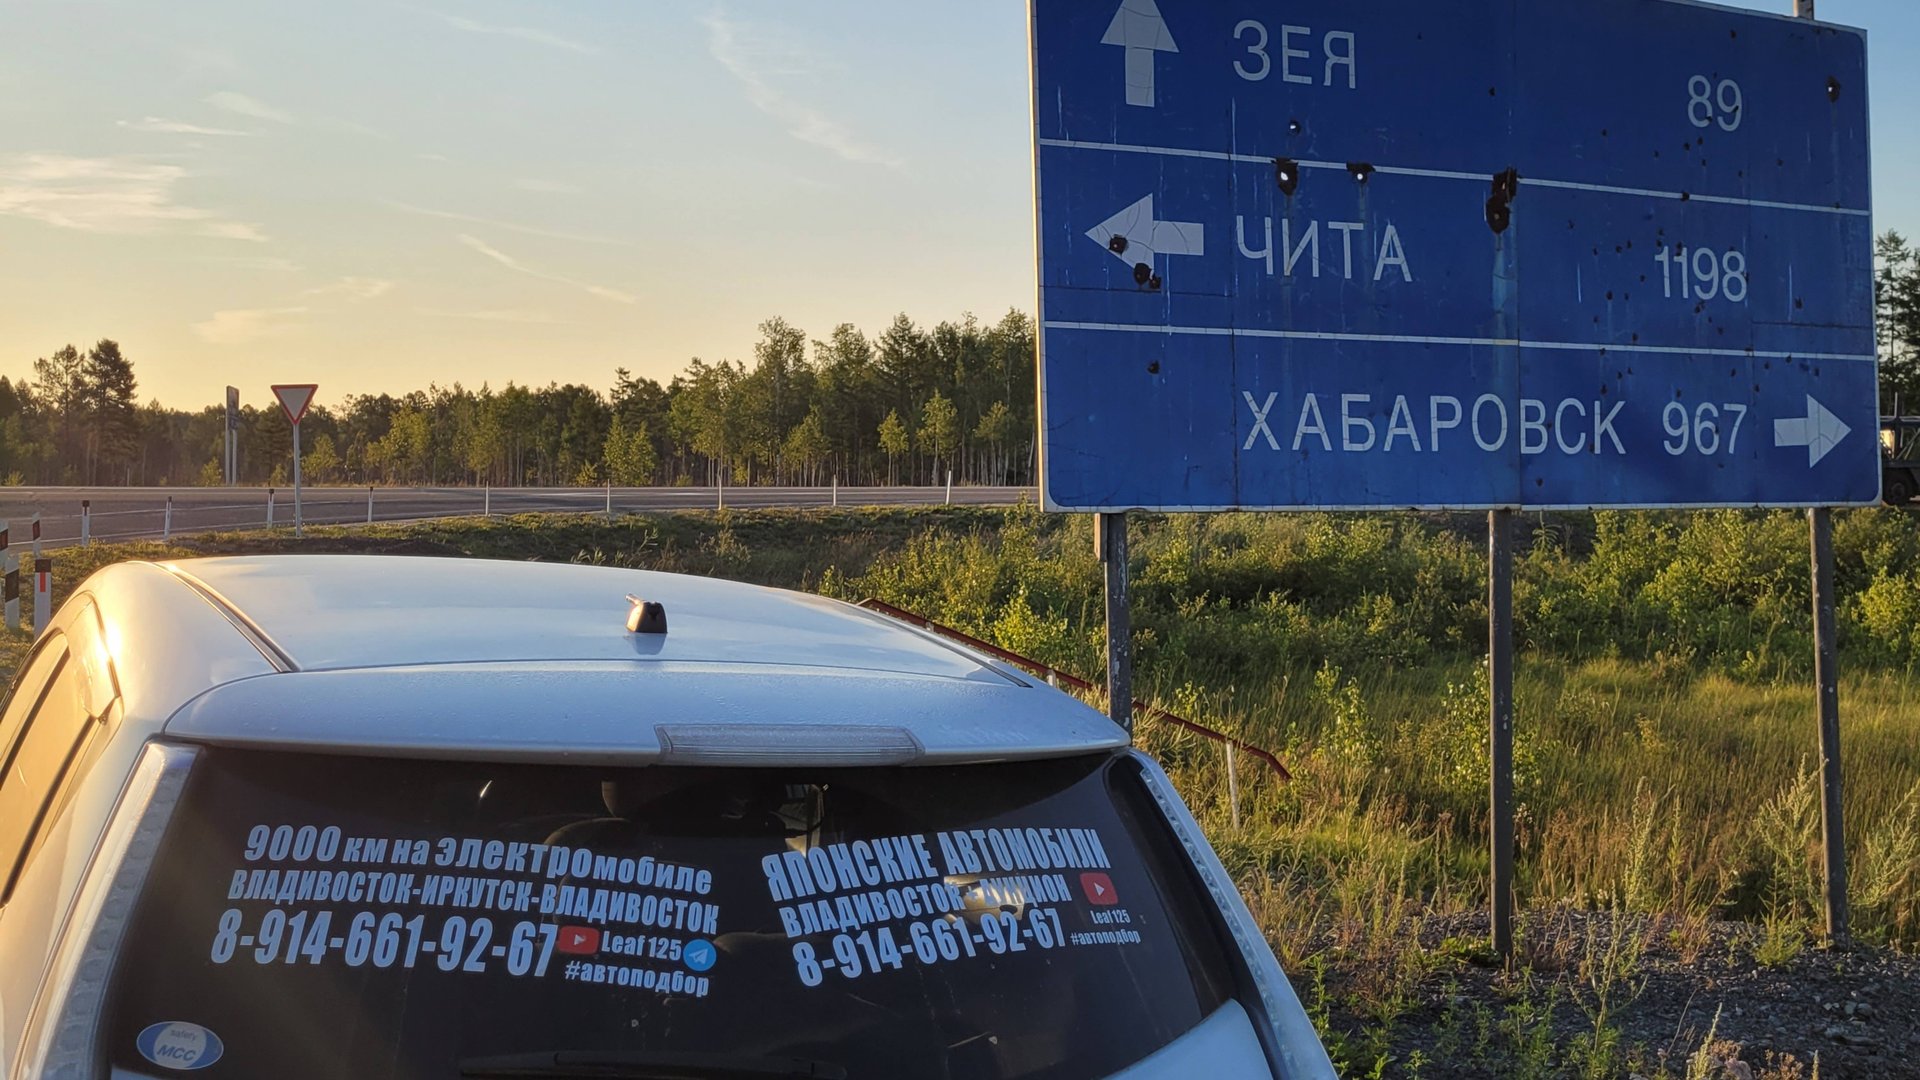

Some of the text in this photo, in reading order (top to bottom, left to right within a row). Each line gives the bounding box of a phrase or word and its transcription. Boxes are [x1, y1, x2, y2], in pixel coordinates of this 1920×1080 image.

[1233, 20, 1356, 89] ЗЕЯ
[1687, 74, 1743, 132] 89
[1237, 215, 1413, 282] ЧИТА
[1654, 246, 1748, 303] 1198
[1242, 390, 1747, 456] ХАБАРОВСК 967
[244, 824, 342, 862] 9000
[342, 837, 389, 863] км
[390, 839, 430, 866] на
[762, 827, 1111, 902] ЯПОНСКИЕ АВТОМОБИЛИ
[227, 869, 720, 935] ВЛАДИВОСТОК-ИРКУТСК-ВЛАДИВОСТОК
[779, 883, 966, 938] ВЛАДИВОСТОК
[1111, 909, 1131, 923] 125
[210, 908, 559, 978] 8-914-661-92-67
[601, 931, 682, 961] Leaf 125
[792, 908, 1066, 987] 8-914-661-92-67
[1070, 928, 1141, 946] #автоподбор
[564, 960, 710, 998] #автоподбор
[157, 1044, 196, 1061] MCC
